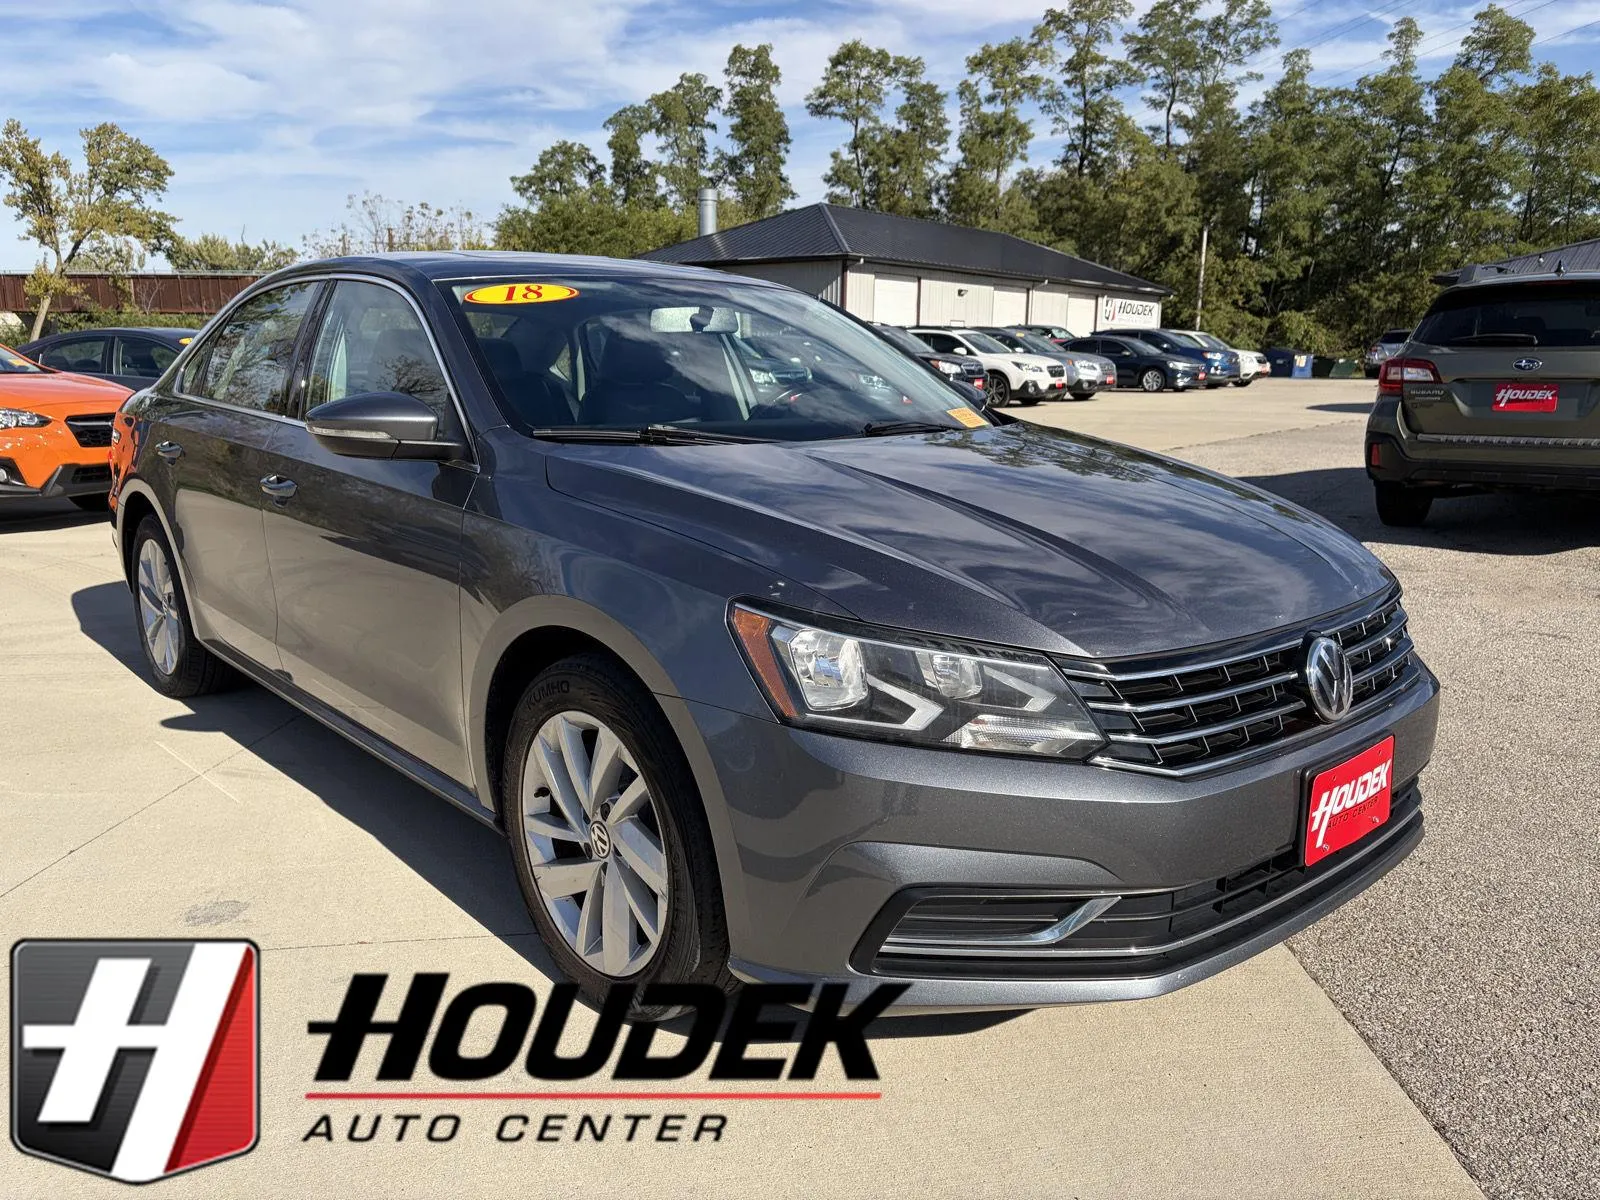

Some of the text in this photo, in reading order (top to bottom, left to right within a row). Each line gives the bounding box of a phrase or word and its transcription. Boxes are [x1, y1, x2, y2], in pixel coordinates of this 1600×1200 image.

[504, 284, 543, 302] 18
[1118, 300, 1155, 317] HOUDEK
[1495, 388, 1557, 408] HOUDEK
[526, 680, 571, 710] KUMHO
[1311, 758, 1392, 849] HOUDEK
[1328, 796, 1379, 829] AUTO CENTER
